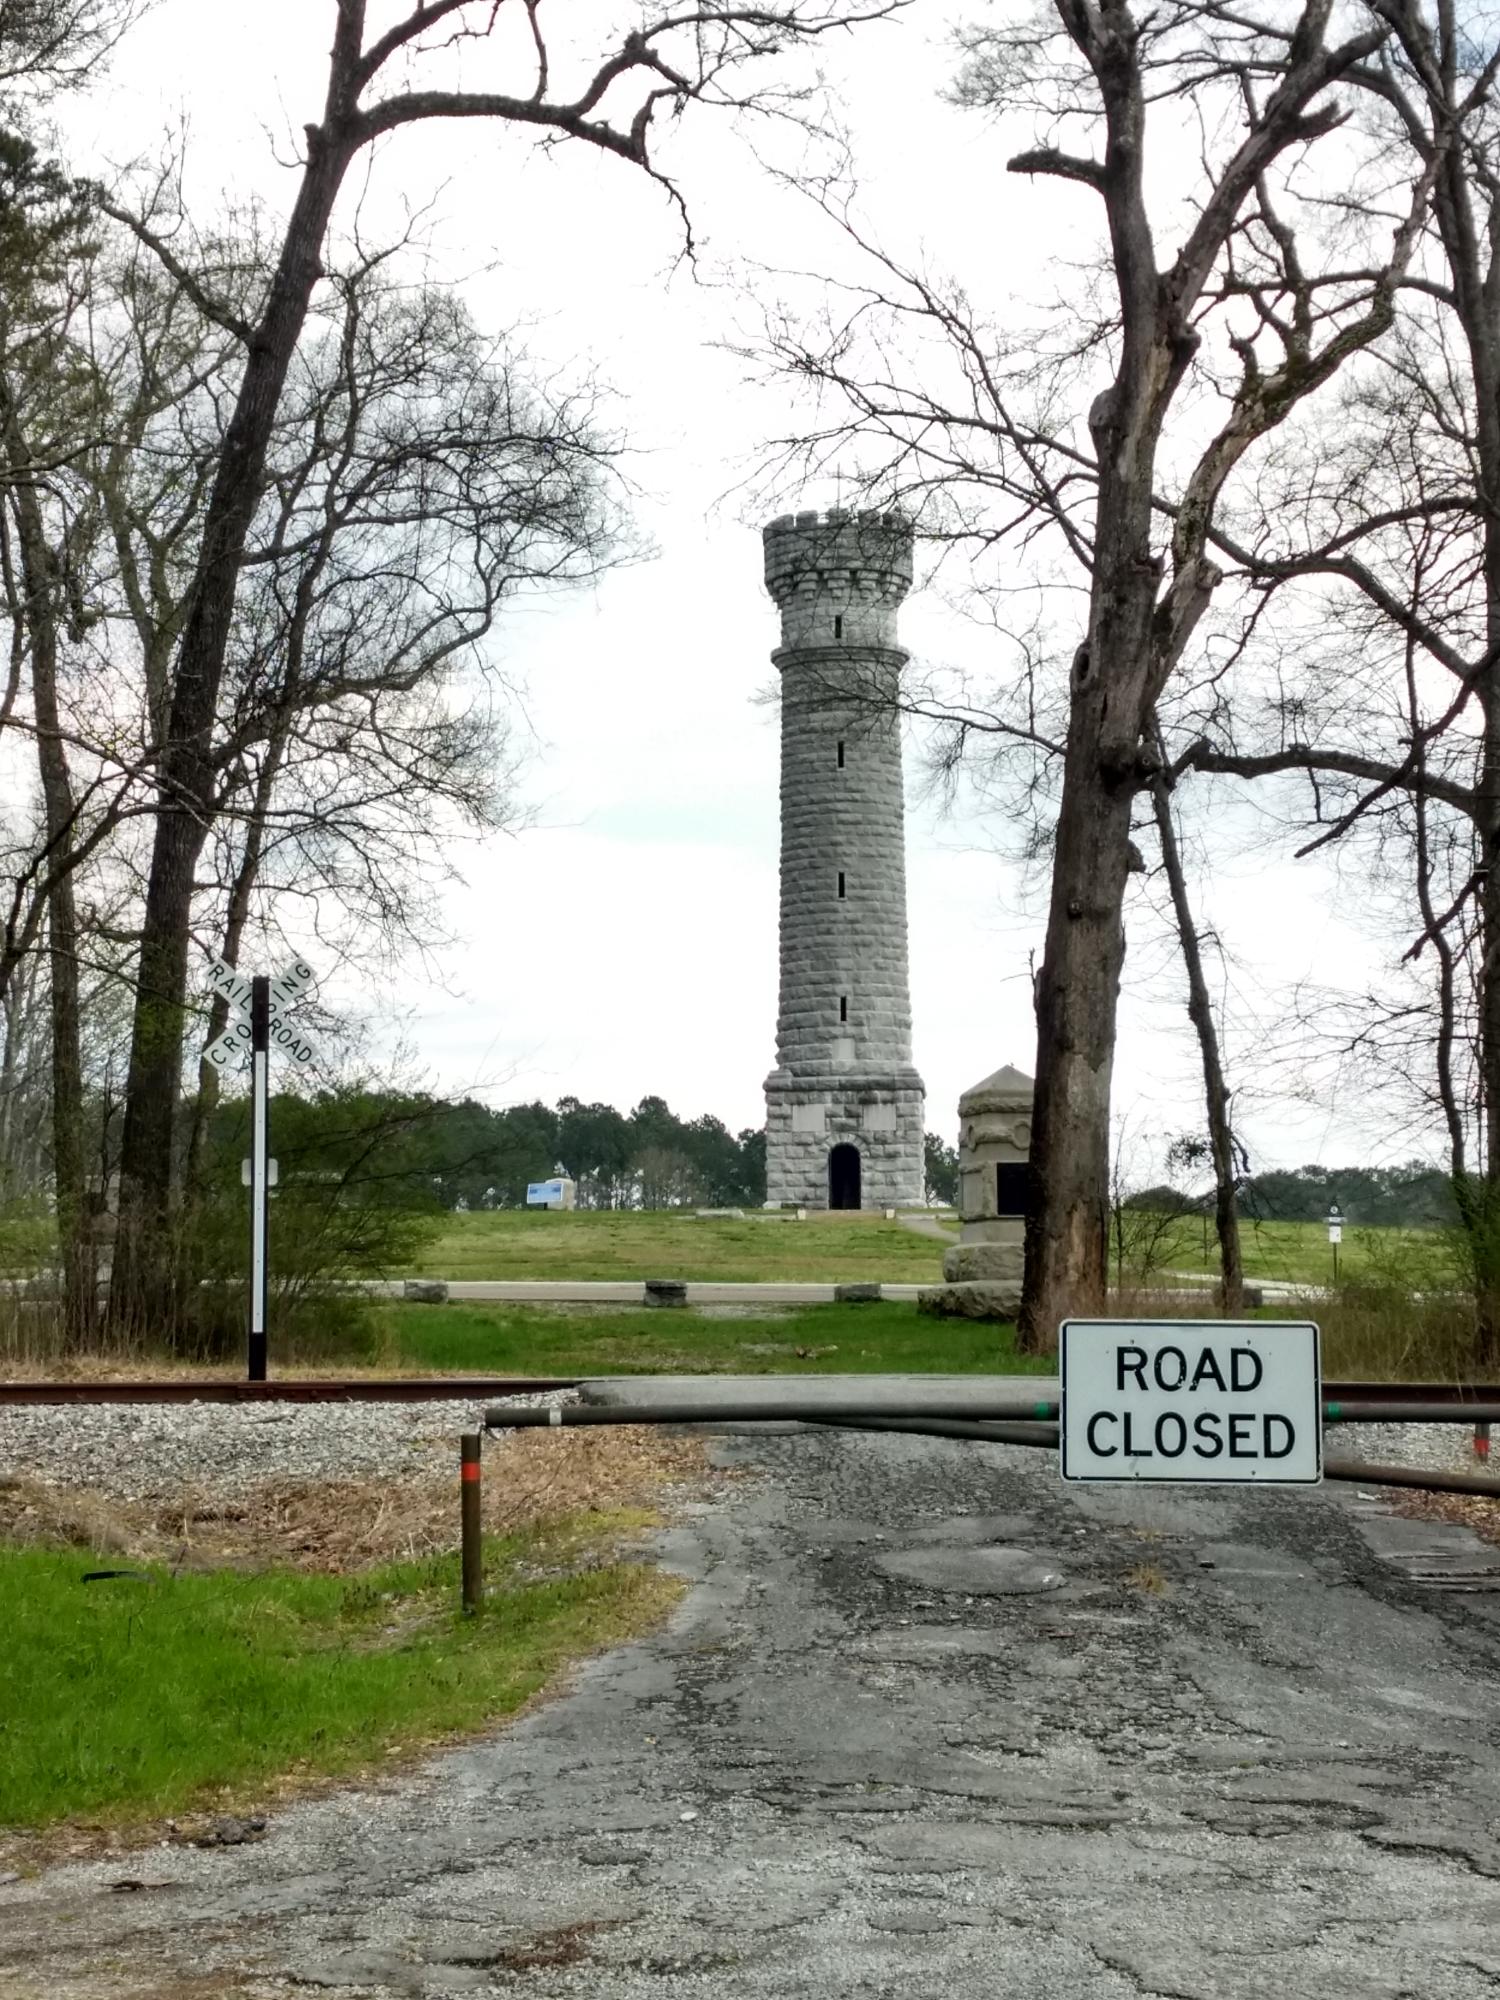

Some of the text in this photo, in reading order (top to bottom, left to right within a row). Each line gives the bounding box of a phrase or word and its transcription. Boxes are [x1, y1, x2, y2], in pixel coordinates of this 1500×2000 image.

[211, 964, 311, 1065] CROING
[1116, 1345, 1263, 1392] ROAD
[1086, 1410, 1296, 1459] CLOSED
